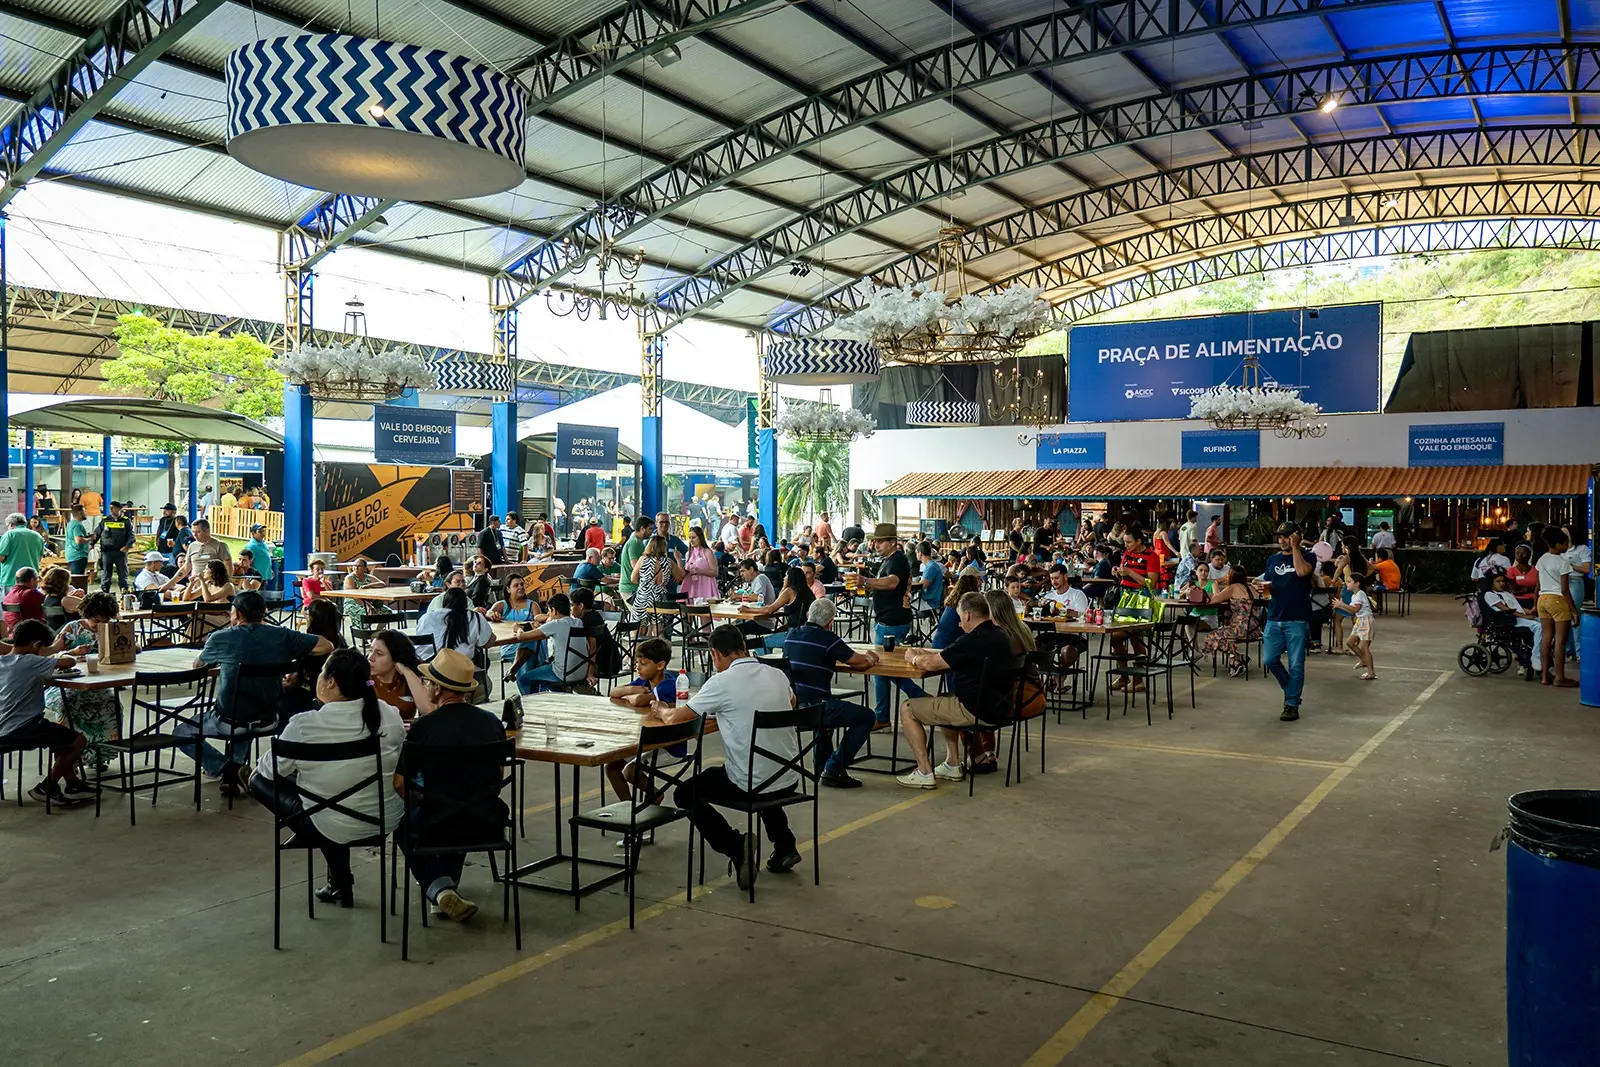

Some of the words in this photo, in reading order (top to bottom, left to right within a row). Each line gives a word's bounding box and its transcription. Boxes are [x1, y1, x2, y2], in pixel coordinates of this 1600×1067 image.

[1098, 345, 1160, 366] PRAÇA
[1165, 343, 1190, 360] DE
[1195, 331, 1343, 357] ALIMENTAÇÃO
[1179, 387, 1205, 395] SICOOB
[379, 422, 401, 431] VALE
[402, 423, 414, 432] DO
[415, 424, 453, 435] EMBOQUE
[393, 434, 440, 445] CERVEJARIA
[572, 437, 604, 447] DIFERENTE
[1413, 437, 1449, 445] COZINHA
[1449, 436, 1498, 444] ARTESANAL
[571, 448, 585, 456] DOS
[585, 448, 604, 457] IGUAIS
[1203, 445, 1237, 453] RUFINO'S
[1418, 444, 1440, 452] VALE
[1453, 443, 1493, 452] EMBOQUE
[330, 508, 362, 532] VALE
[364, 499, 382, 519] DO
[330, 506, 390, 548] EMBOQUE
